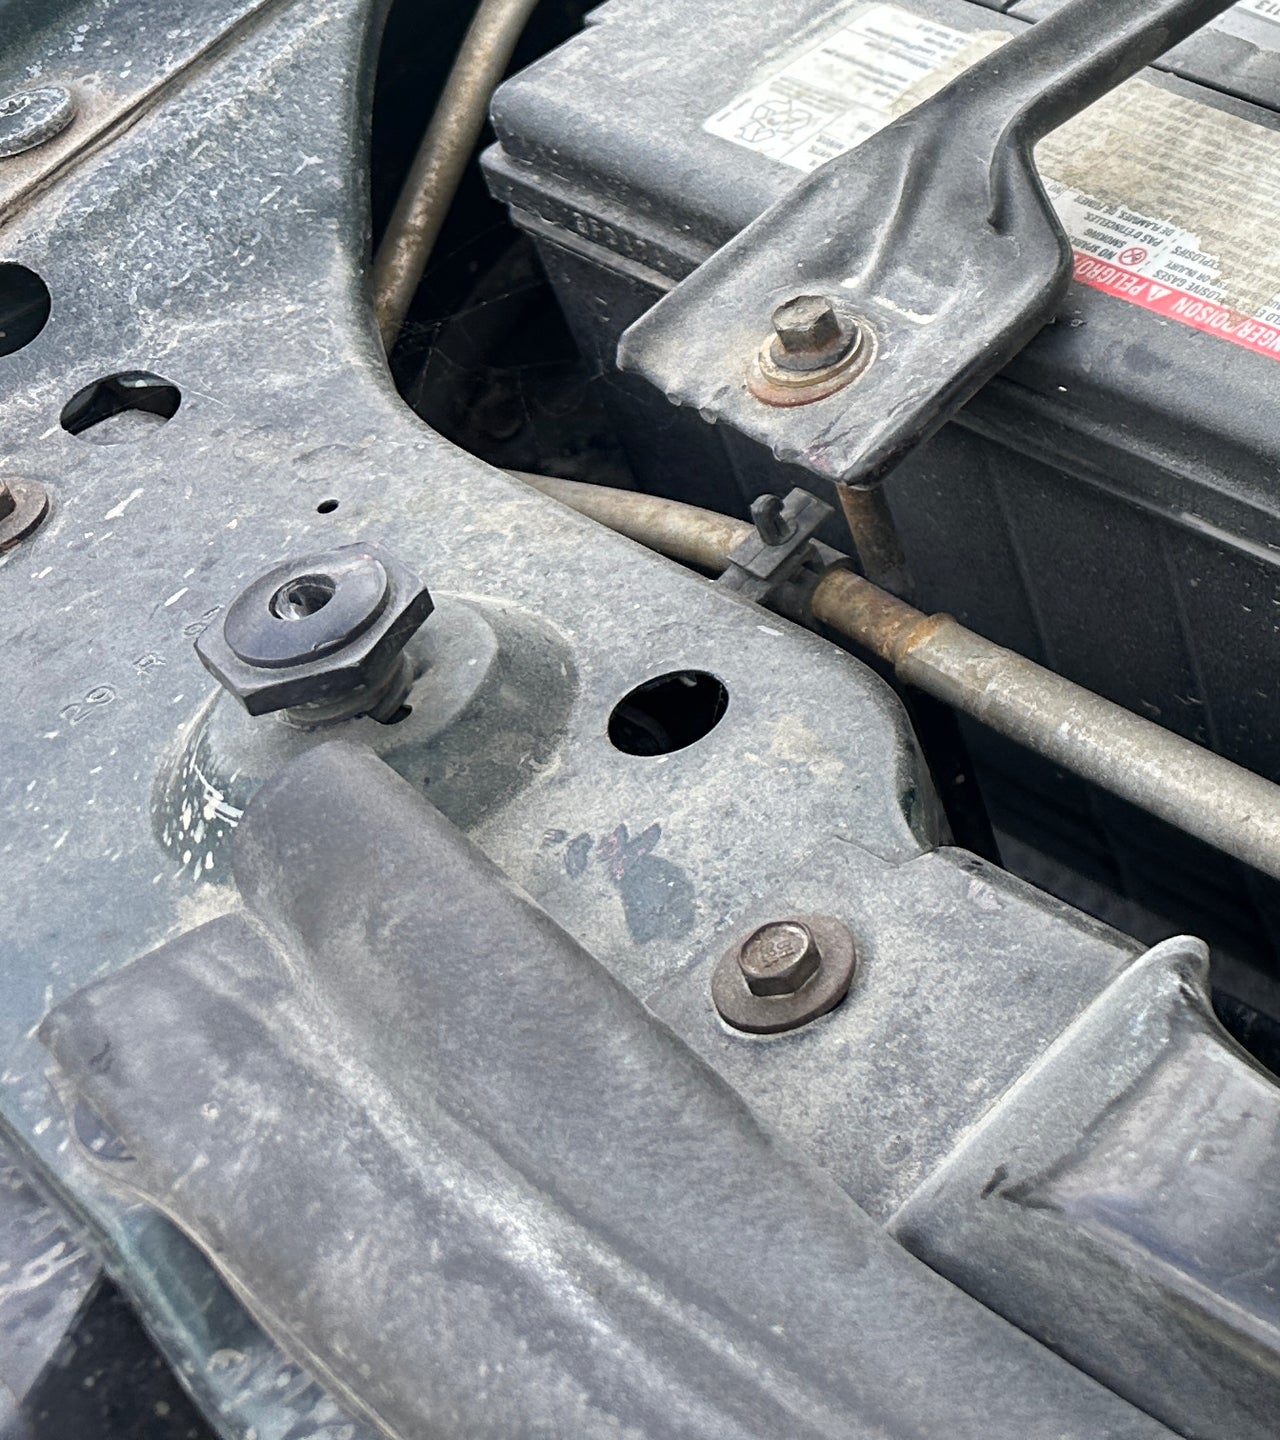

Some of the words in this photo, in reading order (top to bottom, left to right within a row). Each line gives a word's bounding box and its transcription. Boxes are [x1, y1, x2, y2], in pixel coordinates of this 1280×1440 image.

[1139, 233, 1163, 247] PAS
[1098, 247, 1117, 259] NO
[1151, 268, 1187, 287] GASES
